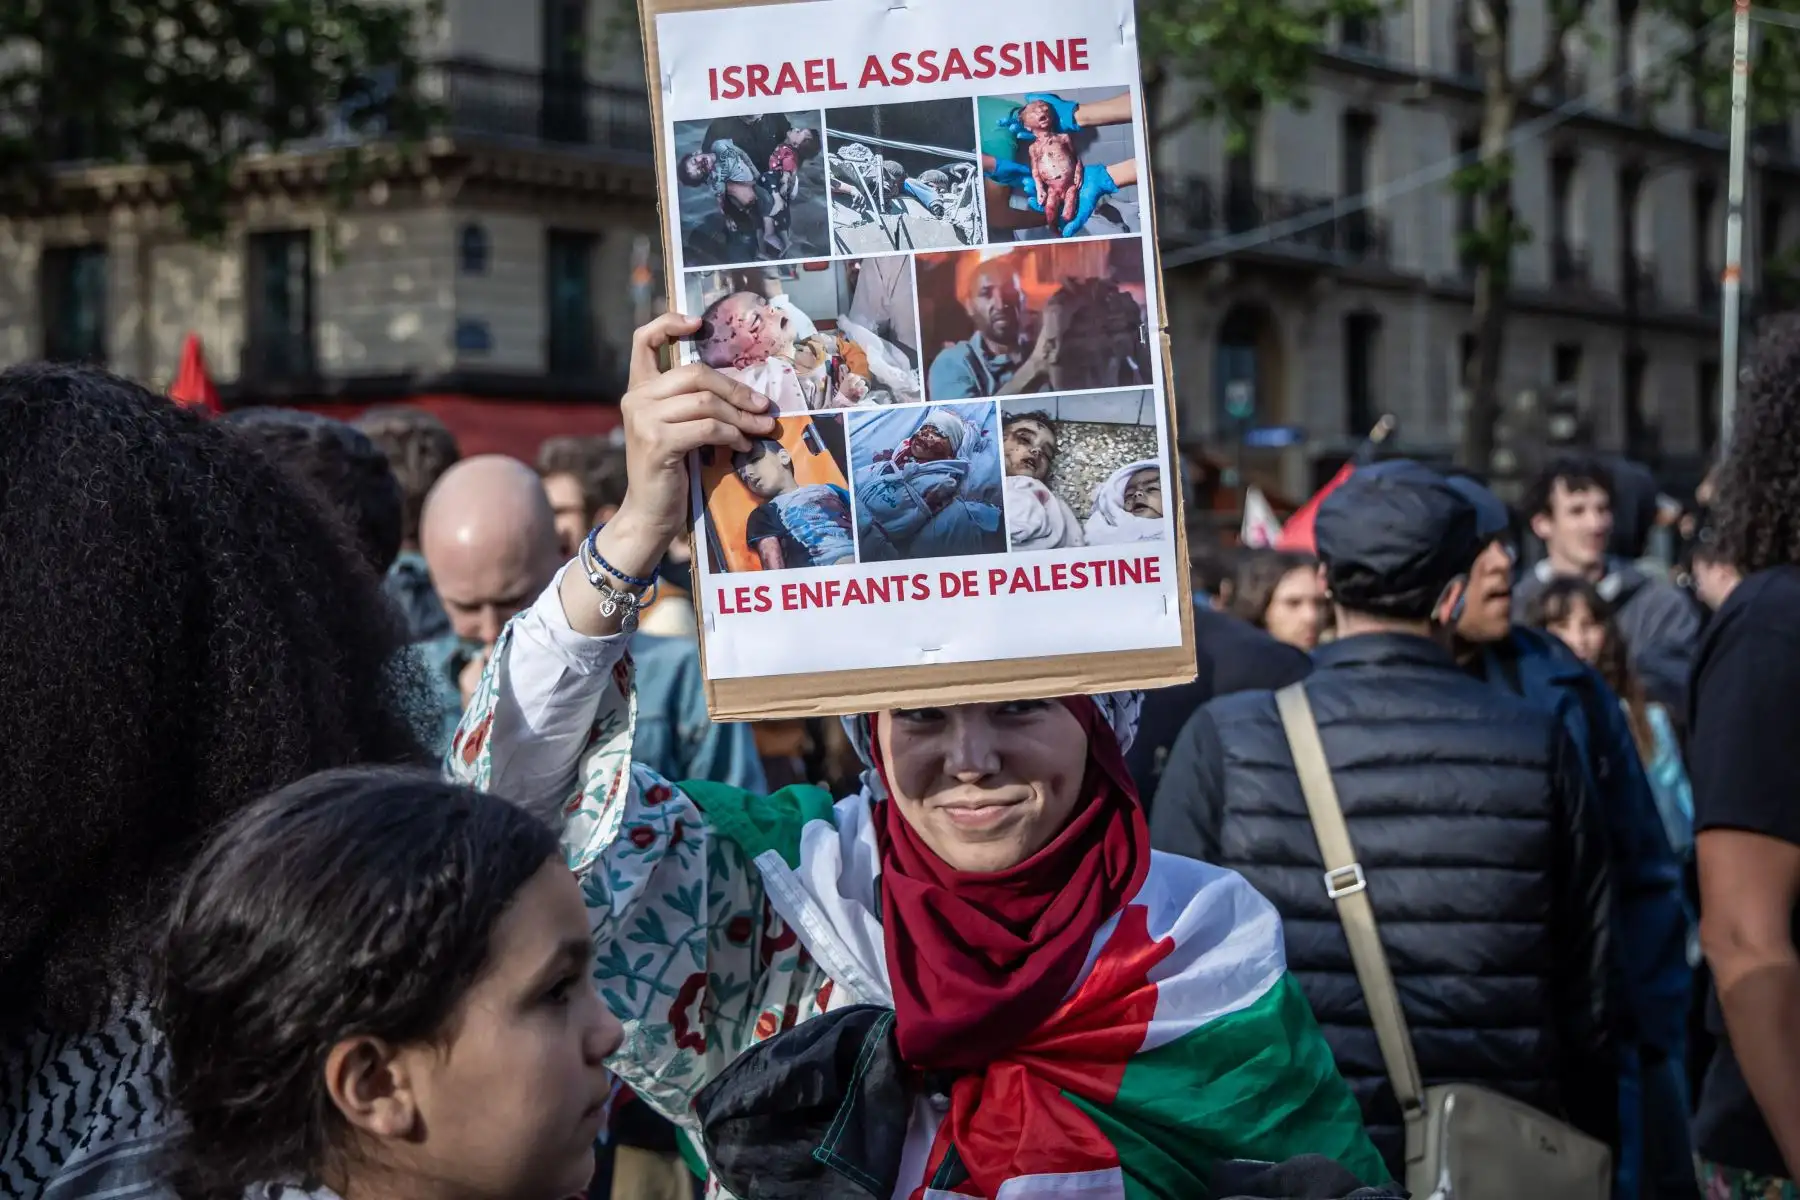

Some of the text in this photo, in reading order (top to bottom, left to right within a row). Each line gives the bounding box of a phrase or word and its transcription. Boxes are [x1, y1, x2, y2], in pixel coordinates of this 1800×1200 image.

[708, 37, 1090, 101] ISRAEL ASSASSINE
[717, 556, 1162, 615] LES ENFANTS DE PALESTINE
